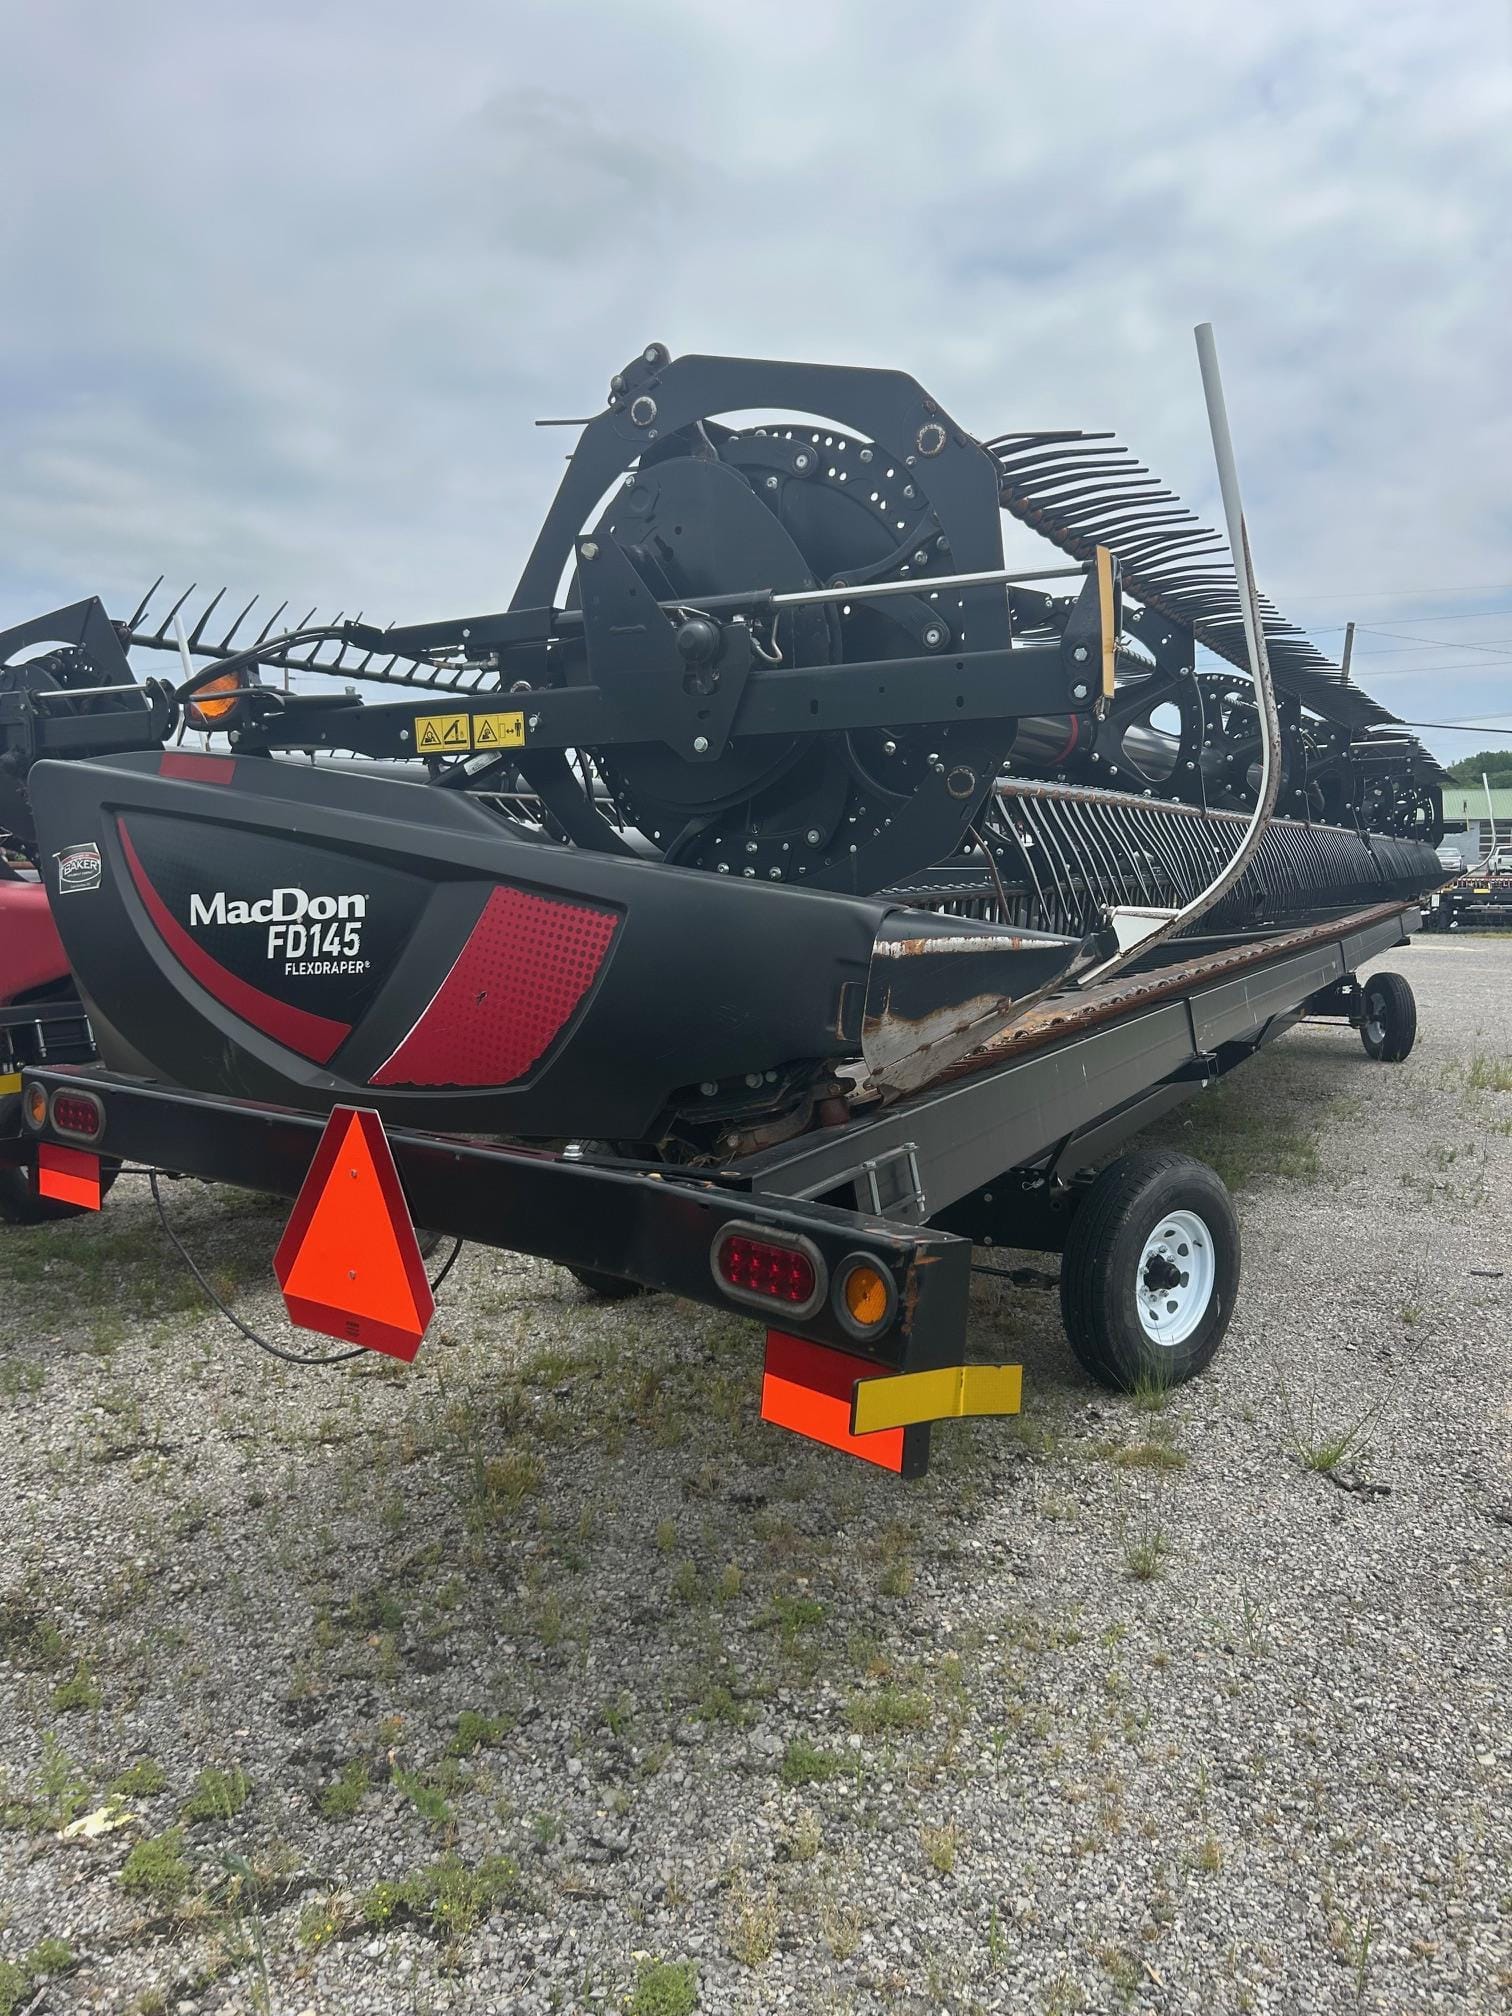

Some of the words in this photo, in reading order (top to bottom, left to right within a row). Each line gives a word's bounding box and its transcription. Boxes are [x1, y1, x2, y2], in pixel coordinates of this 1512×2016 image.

[64, 859, 98, 876] BAKER
[190, 887, 366, 926] MacDon
[267, 921, 362, 959] FD145
